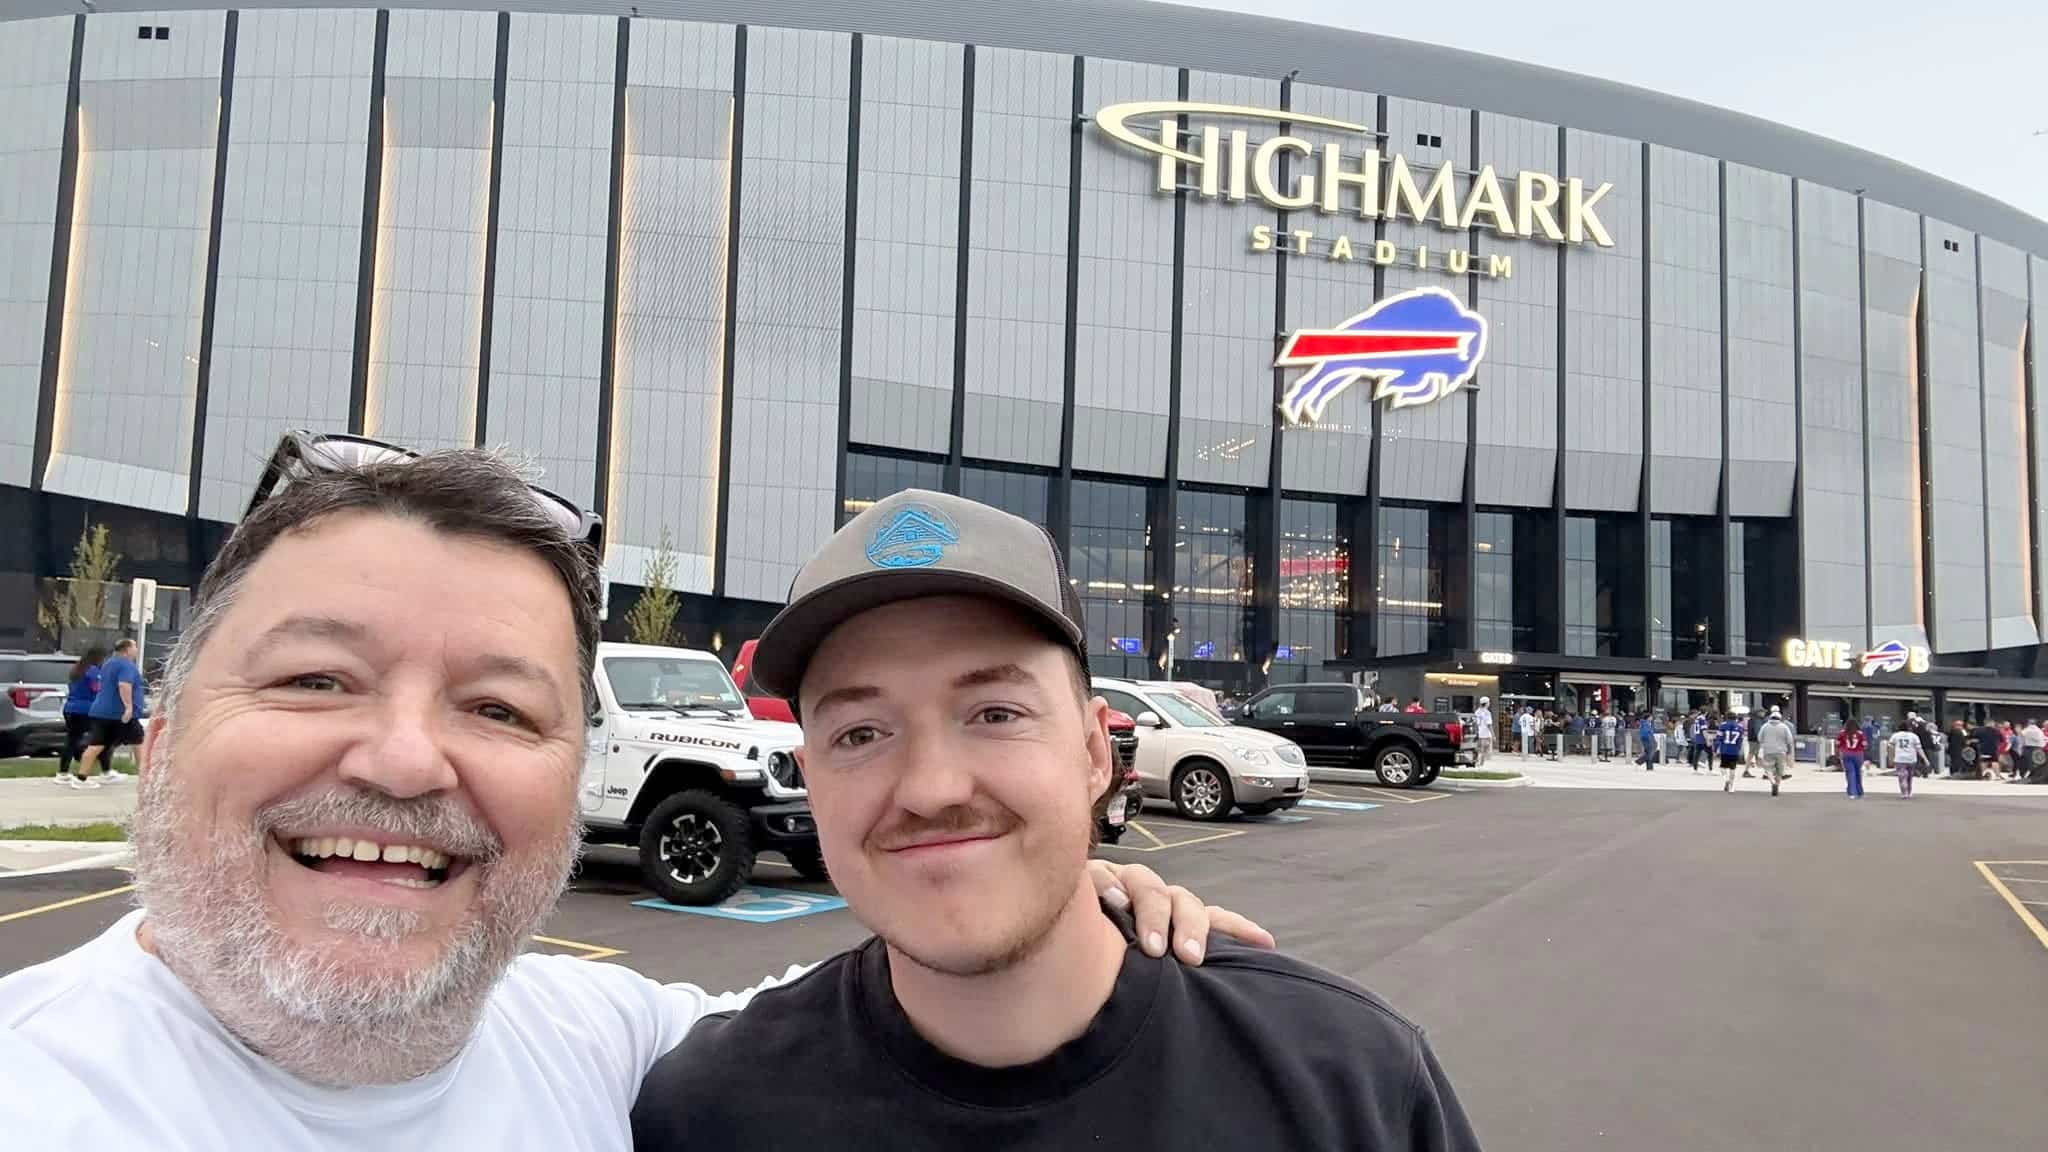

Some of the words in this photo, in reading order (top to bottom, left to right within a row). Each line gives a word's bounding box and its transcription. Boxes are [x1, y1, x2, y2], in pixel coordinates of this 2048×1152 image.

[1157, 118, 1615, 248] HIGHMARK
[1251, 225, 1513, 279] STADIUM
[1785, 638, 1851, 669] GATE
[1910, 646, 1930, 673] B
[649, 732, 741, 750] RUBICON
[1724, 730, 1740, 744] 17
[607, 785, 628, 796] Jeep
